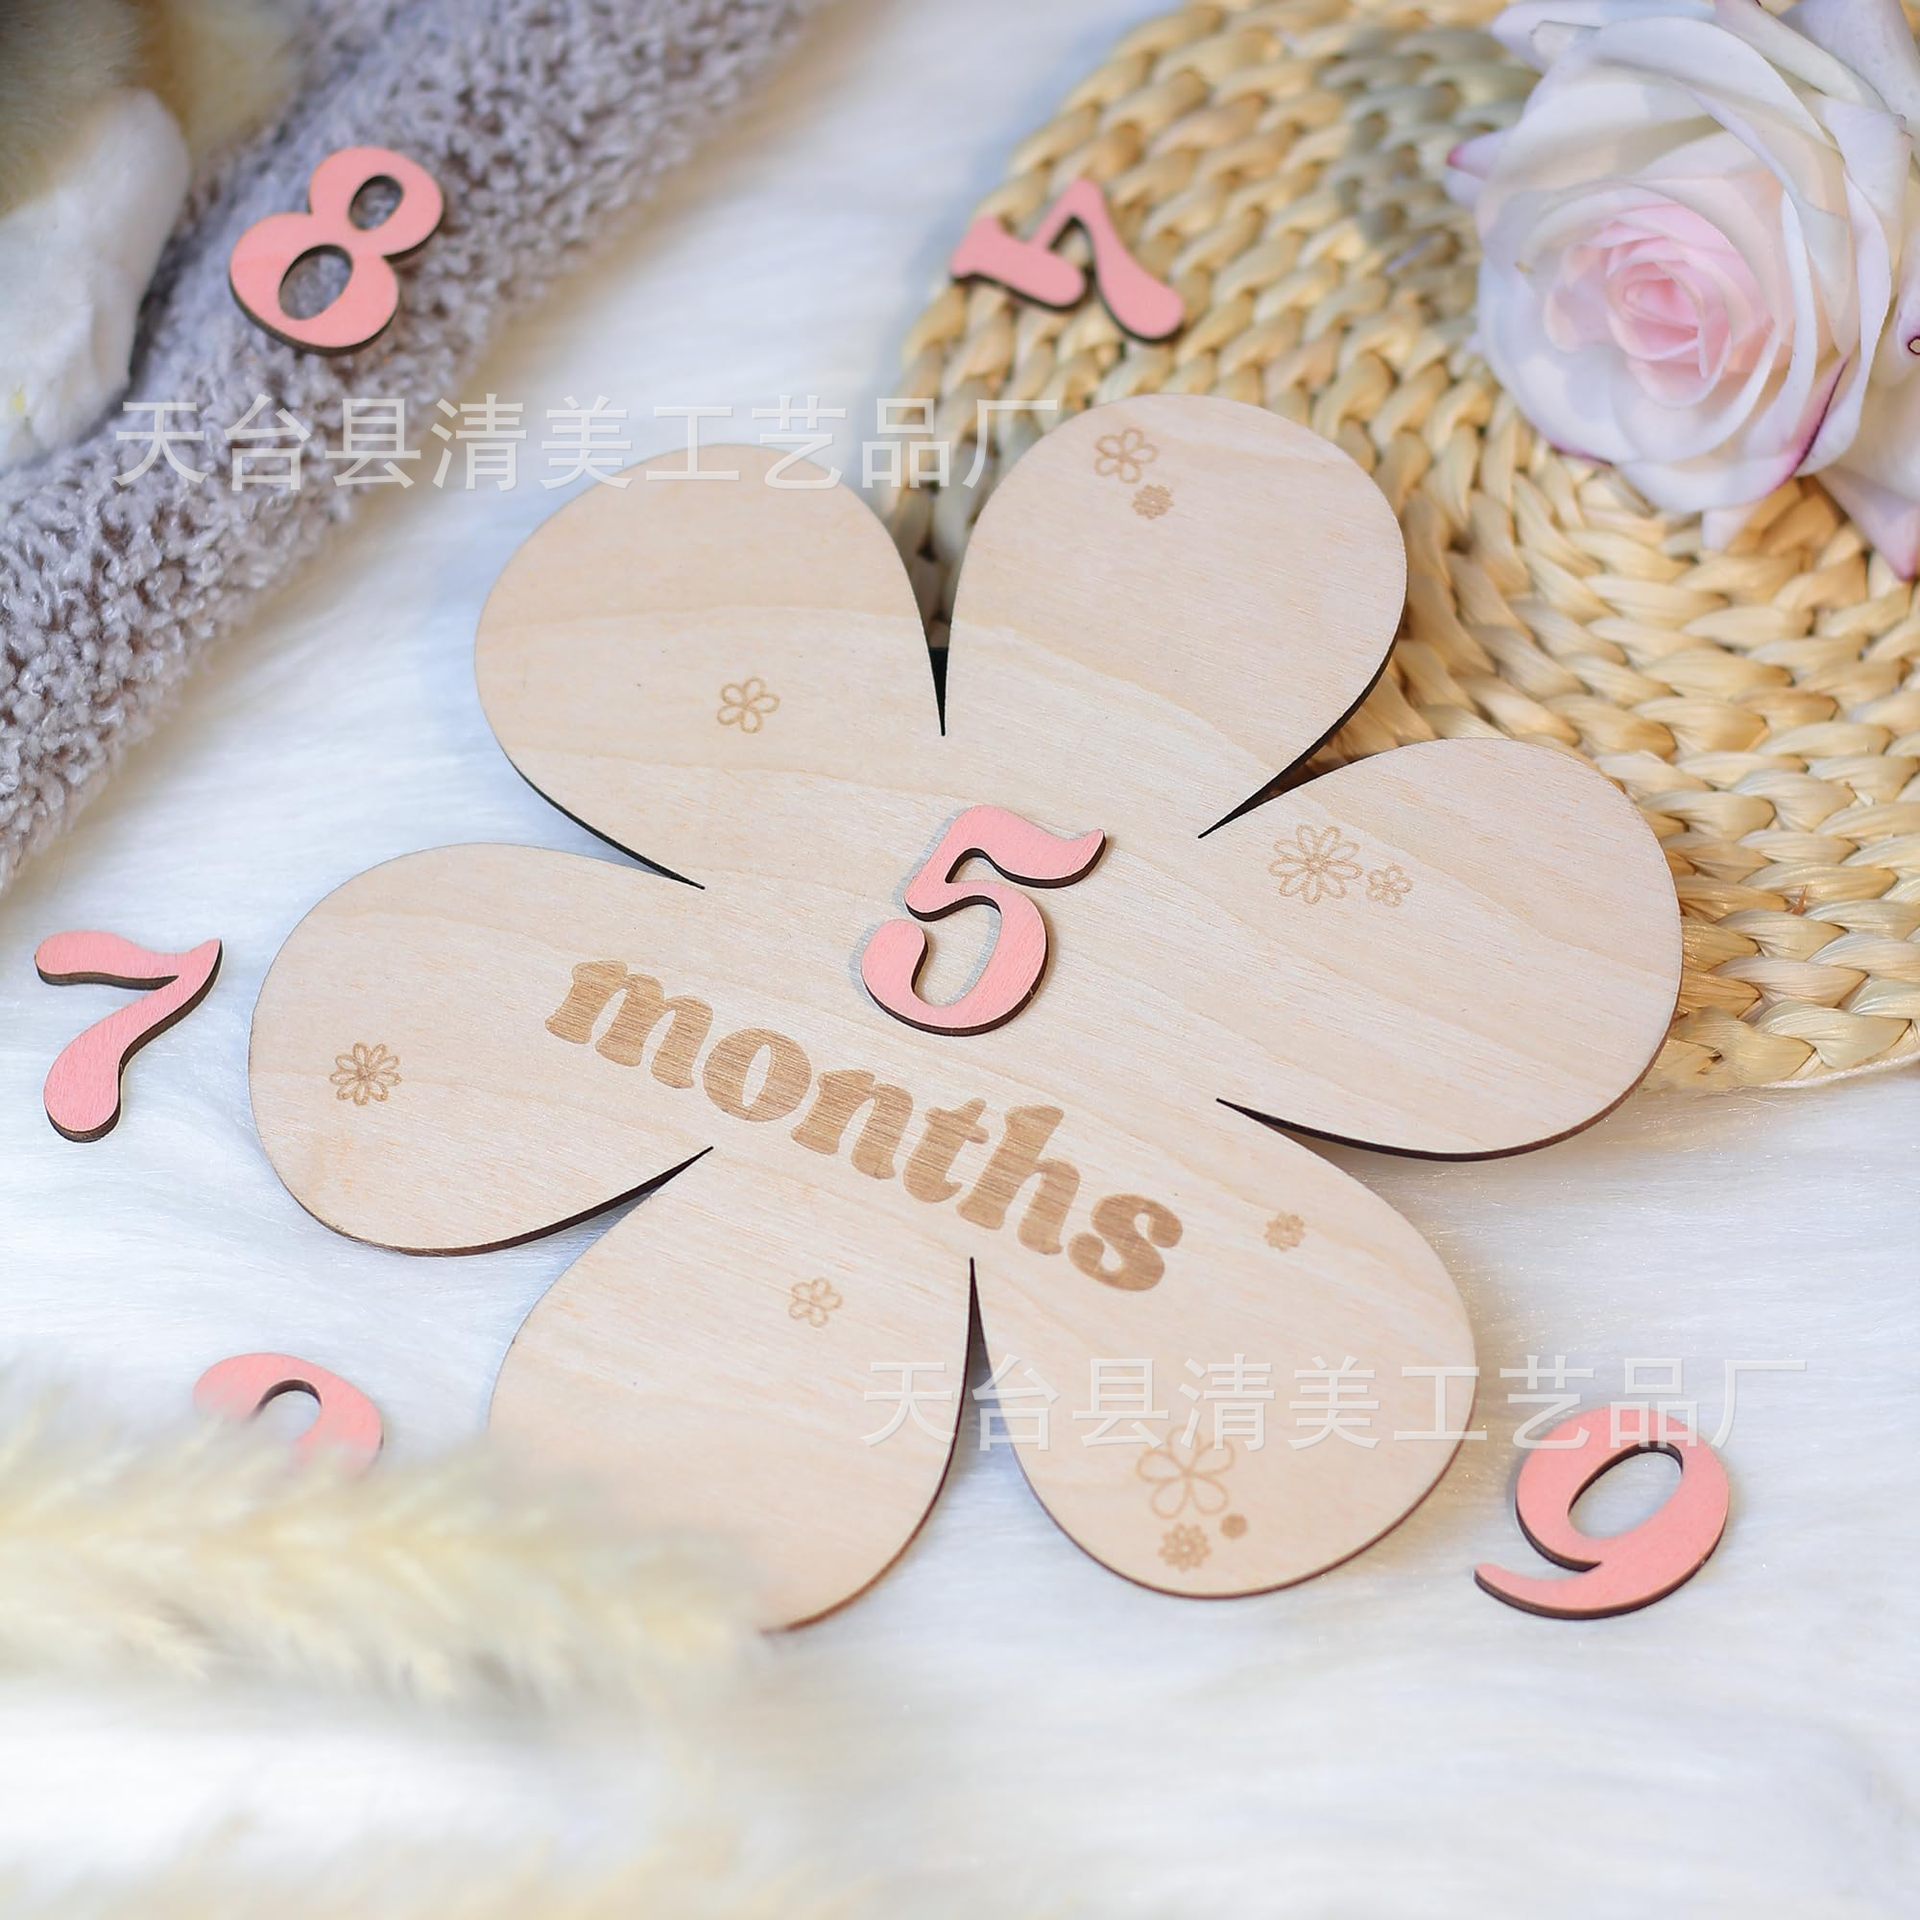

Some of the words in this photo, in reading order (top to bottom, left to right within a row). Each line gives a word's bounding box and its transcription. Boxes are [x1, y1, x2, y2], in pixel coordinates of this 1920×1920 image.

[230, 147, 444, 352] 8
[861, 804, 1106, 1035] 5
[35, 930, 223, 1141] 7
[545, 960, 1183, 1292] months
[1474, 1405, 1730, 1619] 9
